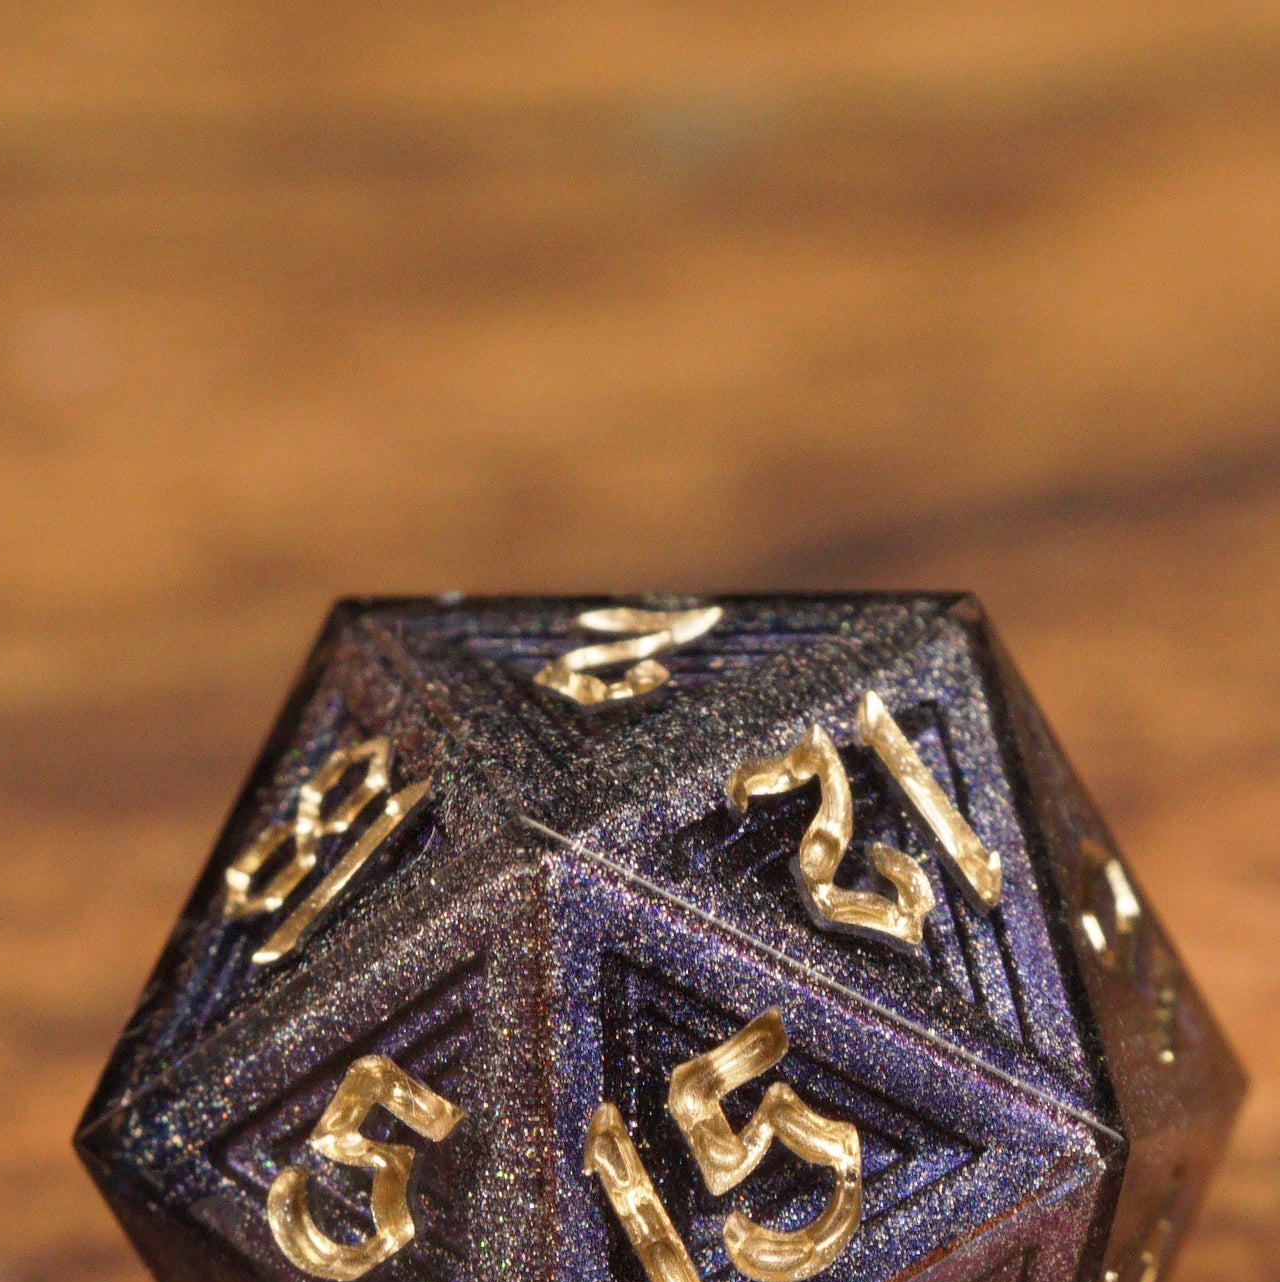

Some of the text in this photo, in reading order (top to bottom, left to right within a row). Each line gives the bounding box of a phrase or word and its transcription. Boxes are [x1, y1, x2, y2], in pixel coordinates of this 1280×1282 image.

[224, 736, 431, 965] 18
[725, 689, 1002, 945] 12
[268, 1055, 465, 1282] 5
